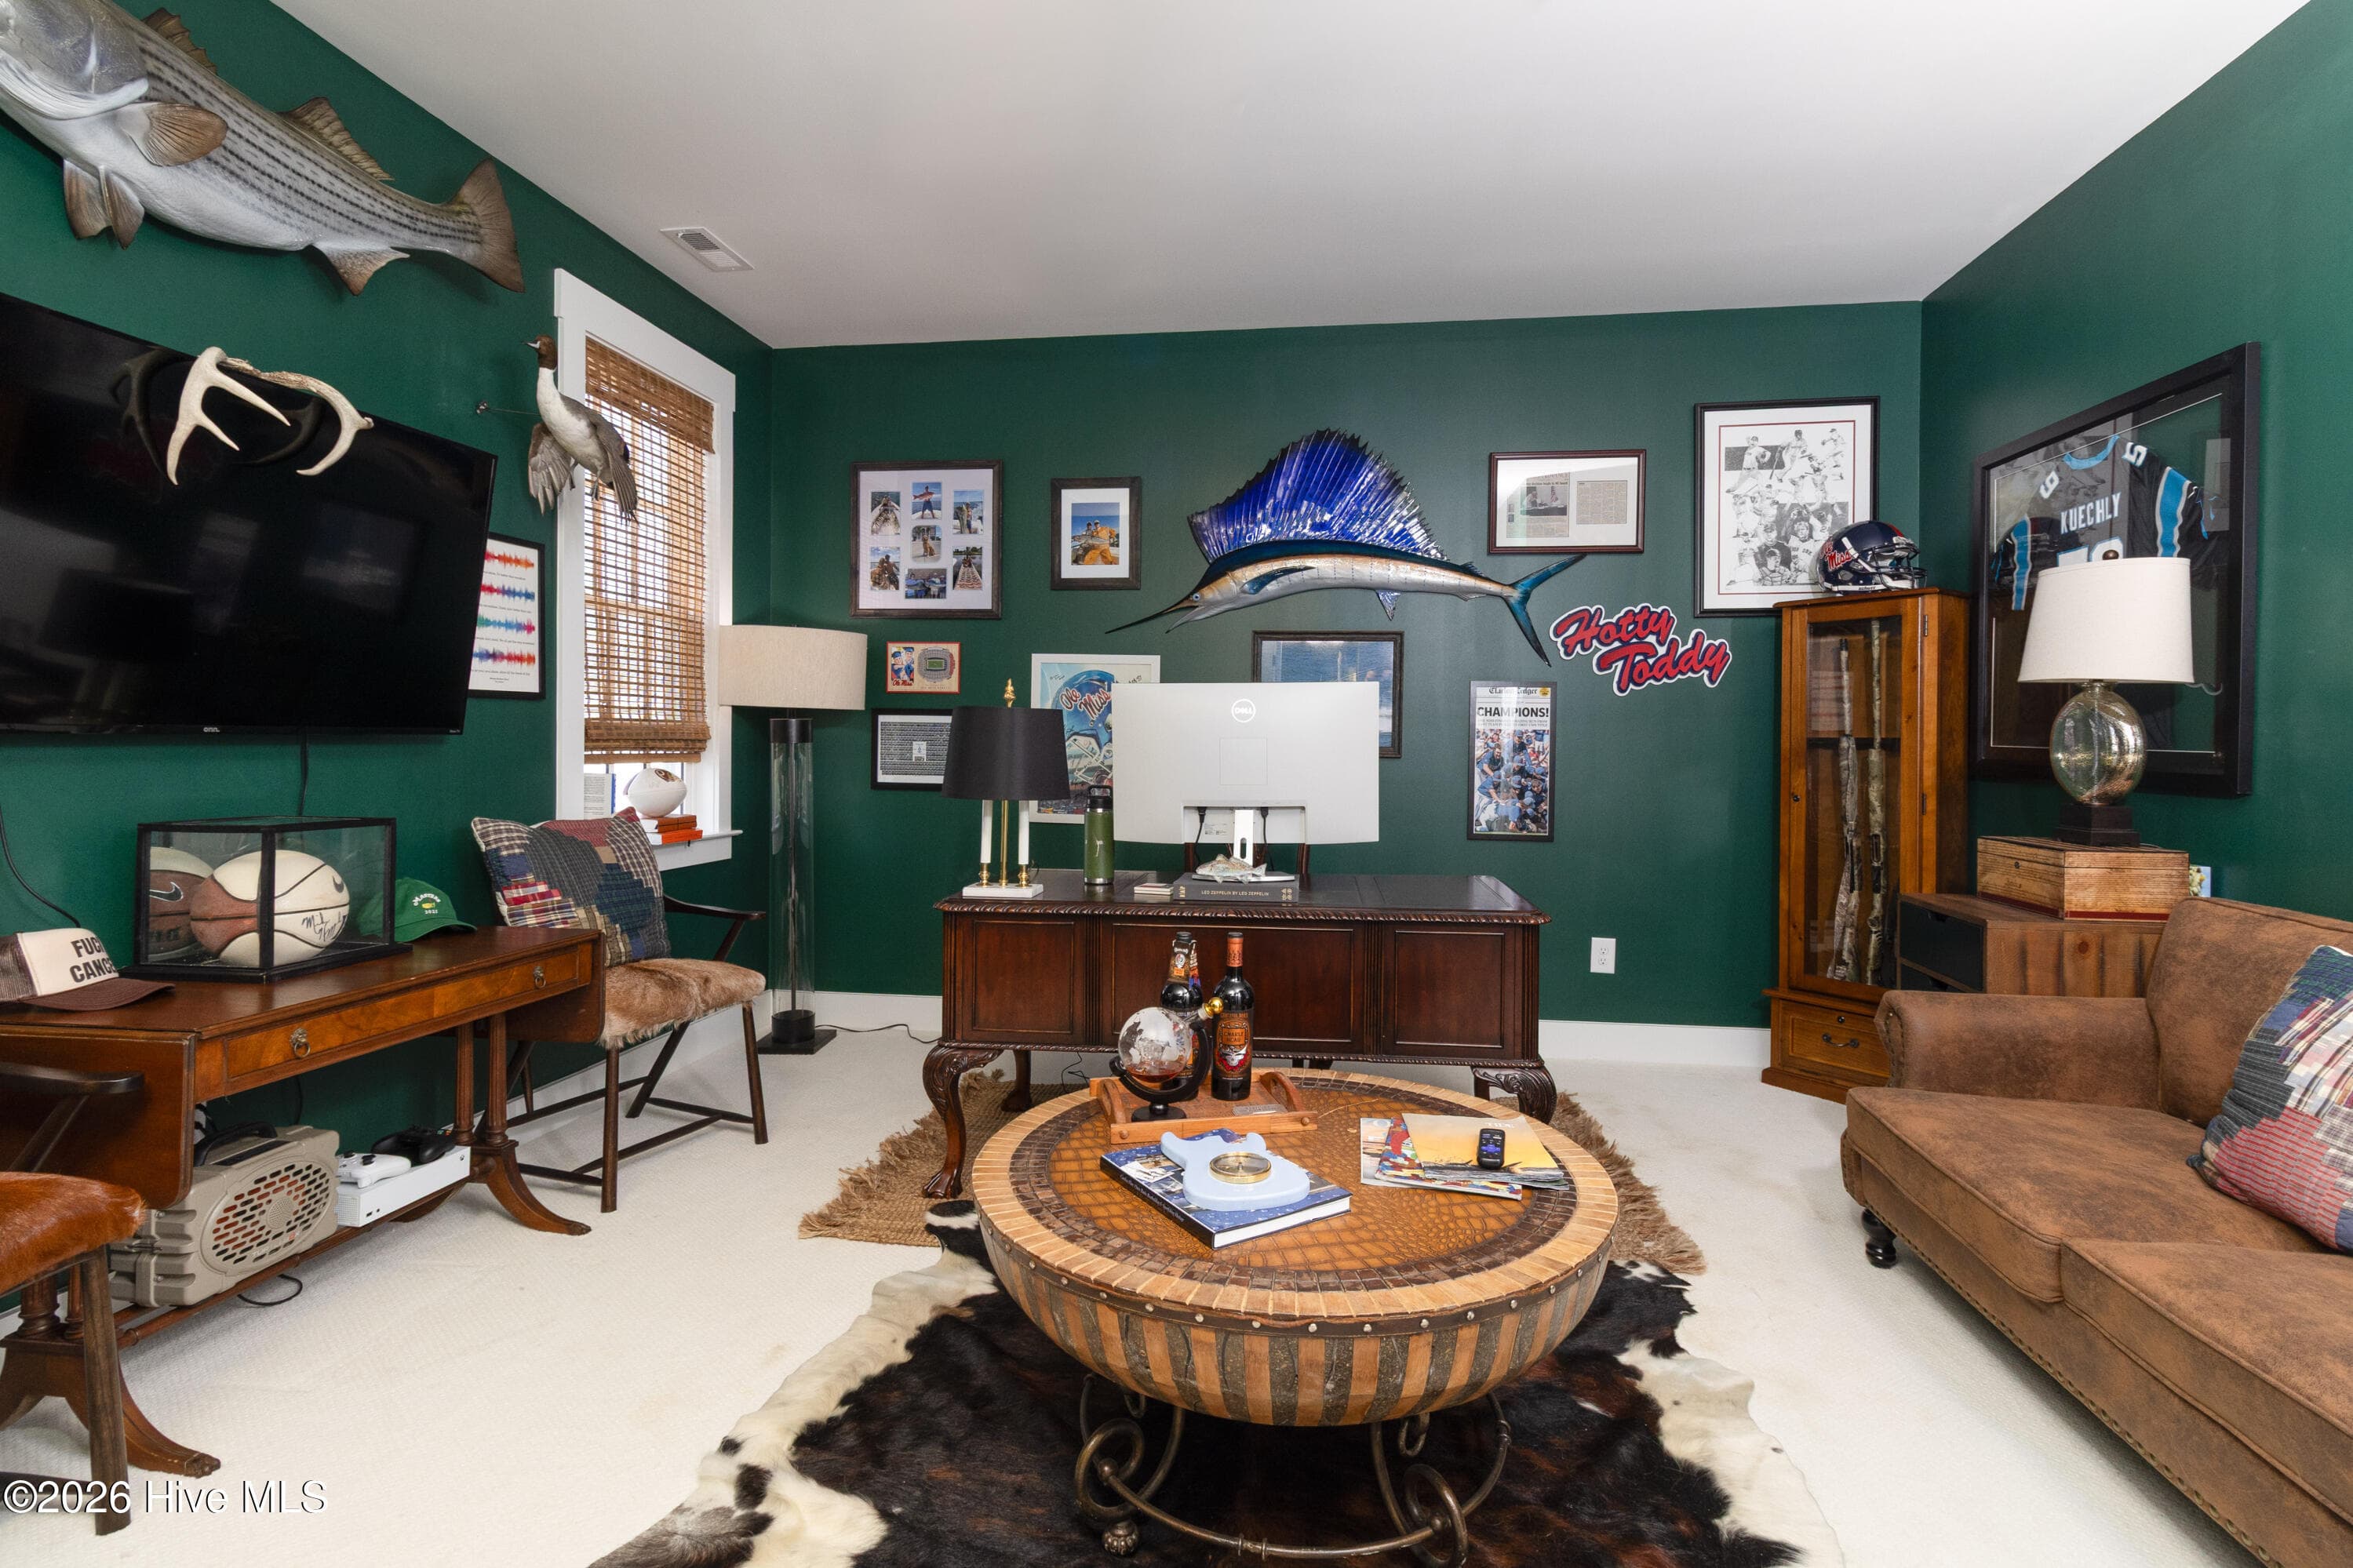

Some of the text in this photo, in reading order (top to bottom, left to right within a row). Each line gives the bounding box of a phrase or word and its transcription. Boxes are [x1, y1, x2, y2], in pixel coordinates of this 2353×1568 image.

[2060, 492, 2122, 535] KUECHLY
[1824, 550, 1853, 572] Miss
[1552, 605, 1676, 658] Hotty
[1594, 630, 1731, 695] Toddy
[1060, 687, 1080, 710] Ole
[1078, 689, 1112, 720] Miss
[1477, 707, 1550, 718] CHAMPIONS!
